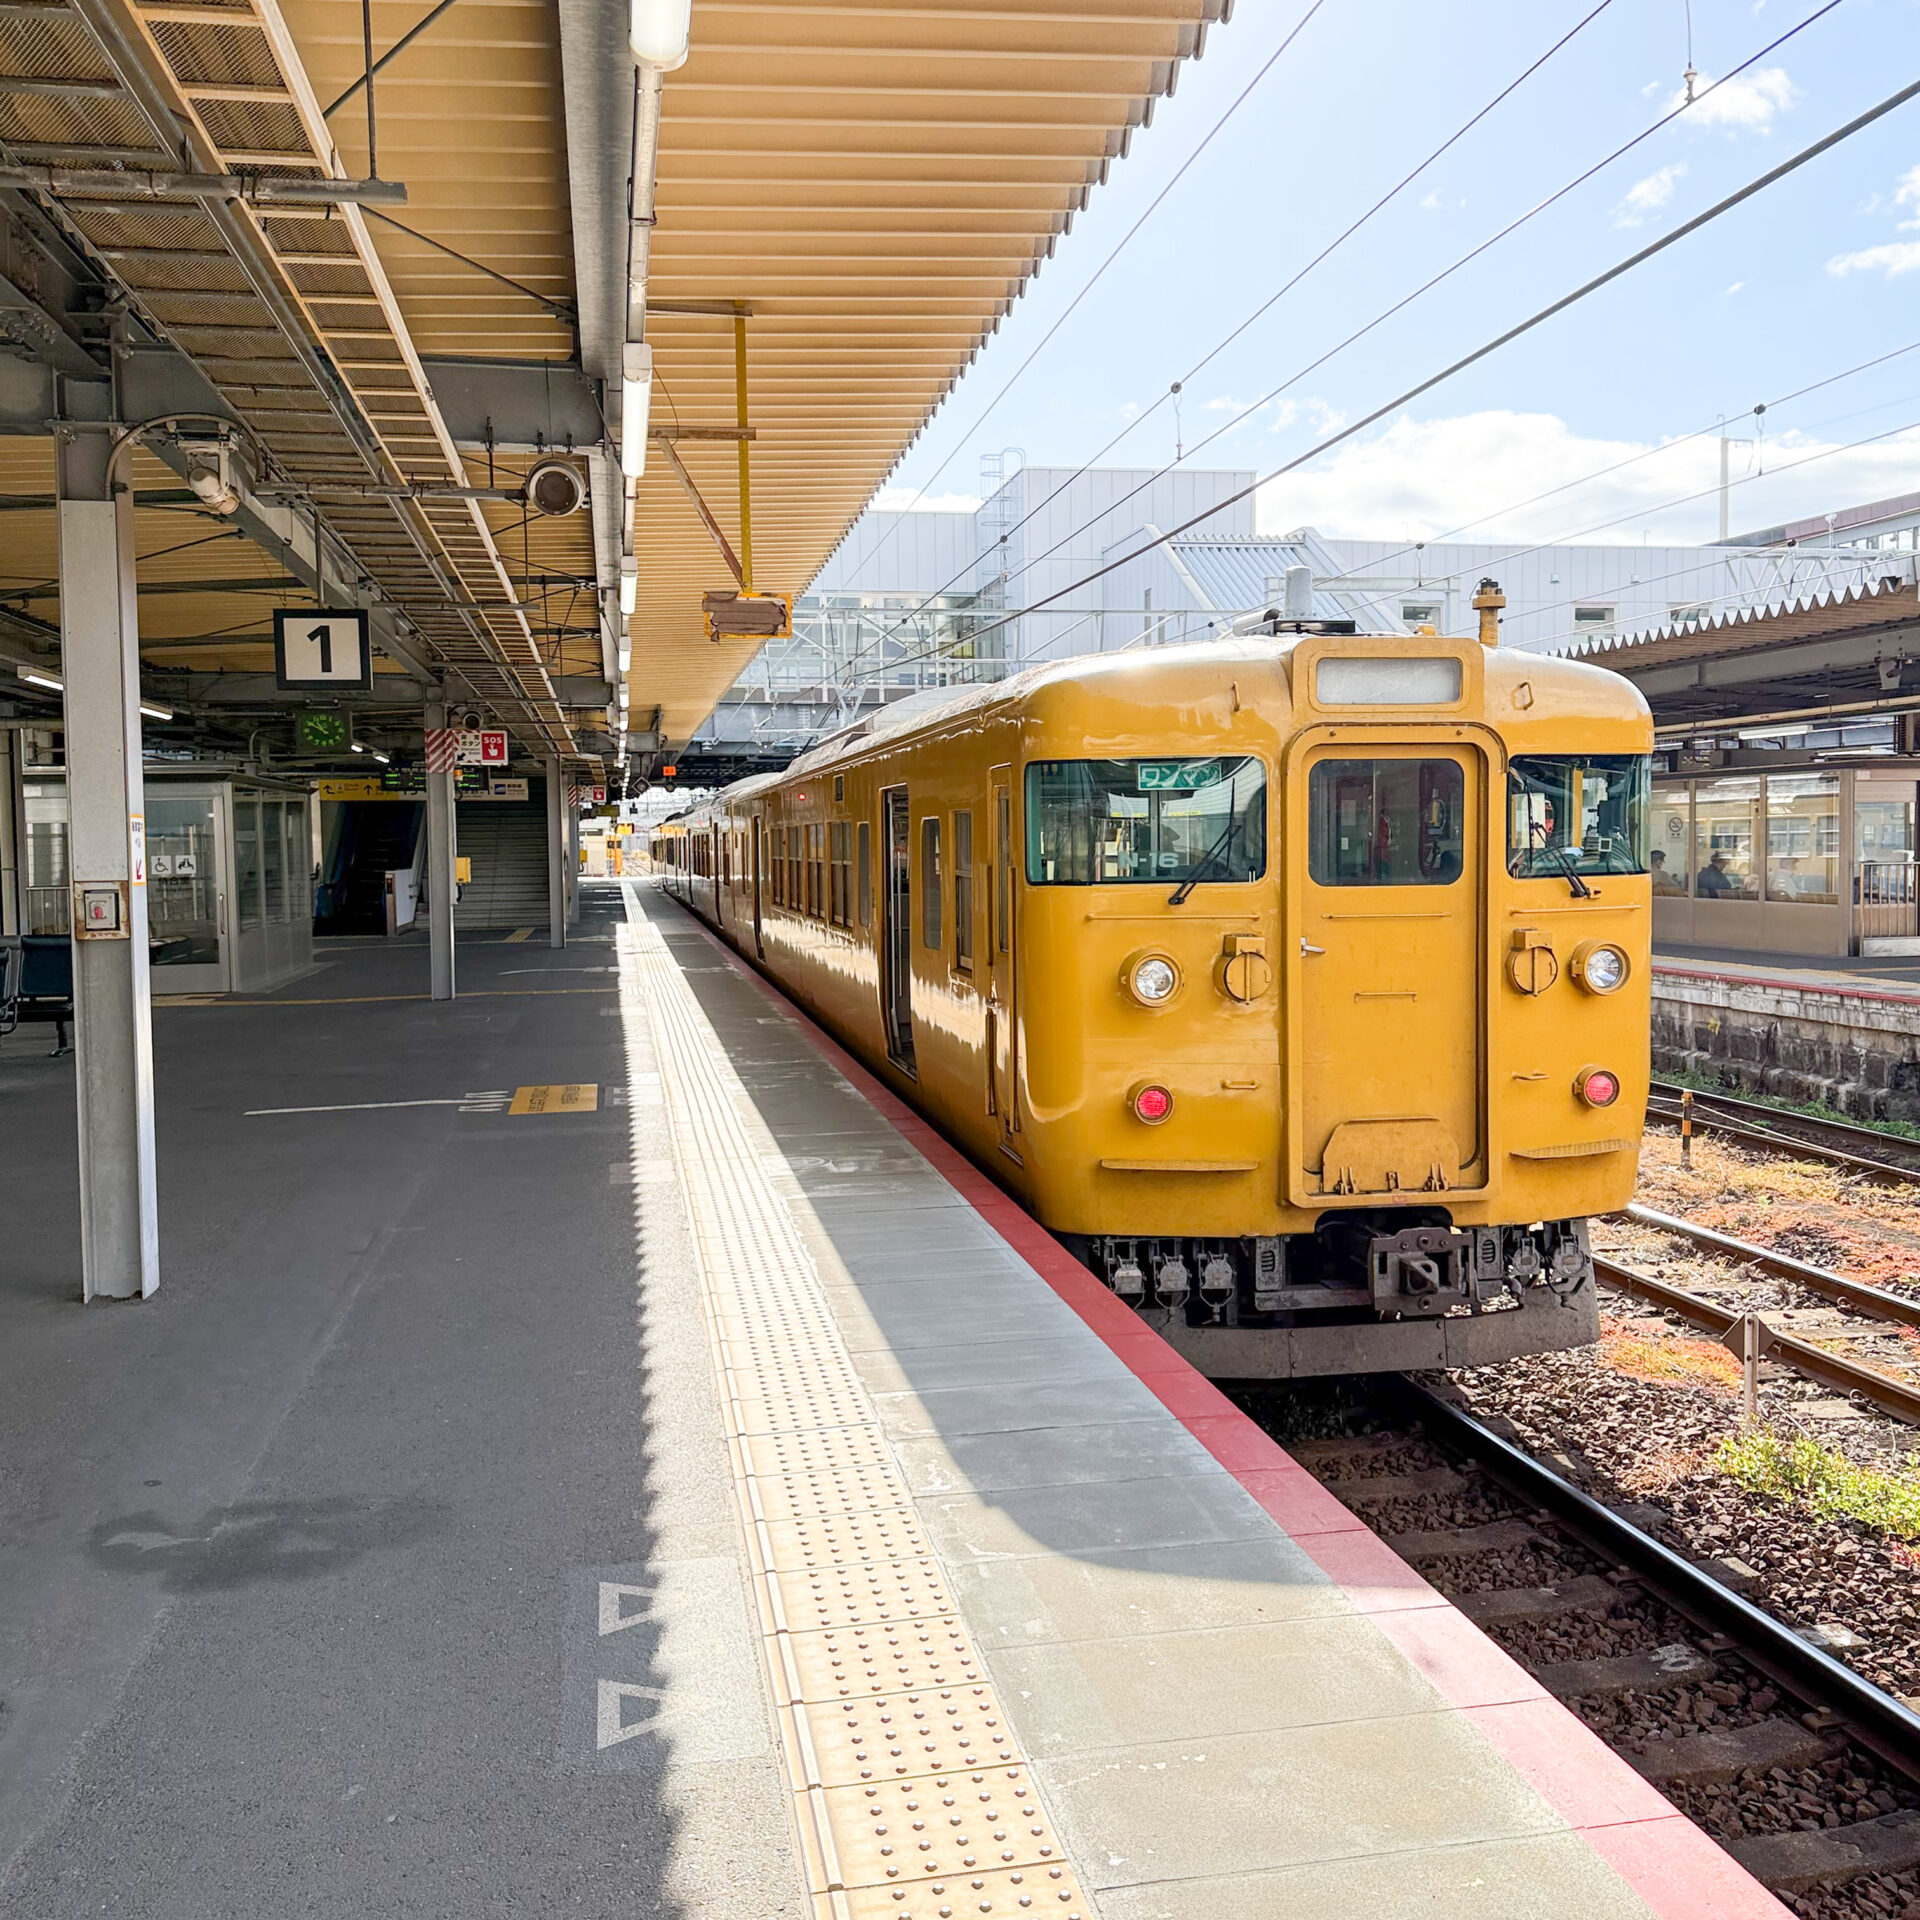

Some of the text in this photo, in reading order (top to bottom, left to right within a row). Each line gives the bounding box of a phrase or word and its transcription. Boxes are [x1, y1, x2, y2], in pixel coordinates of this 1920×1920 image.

[307, 625, 332, 673] 1
[483, 736, 502, 744] SOS
[1142, 767, 1219, 787] ワンマン
[1118, 852, 1179, 868] N-16
